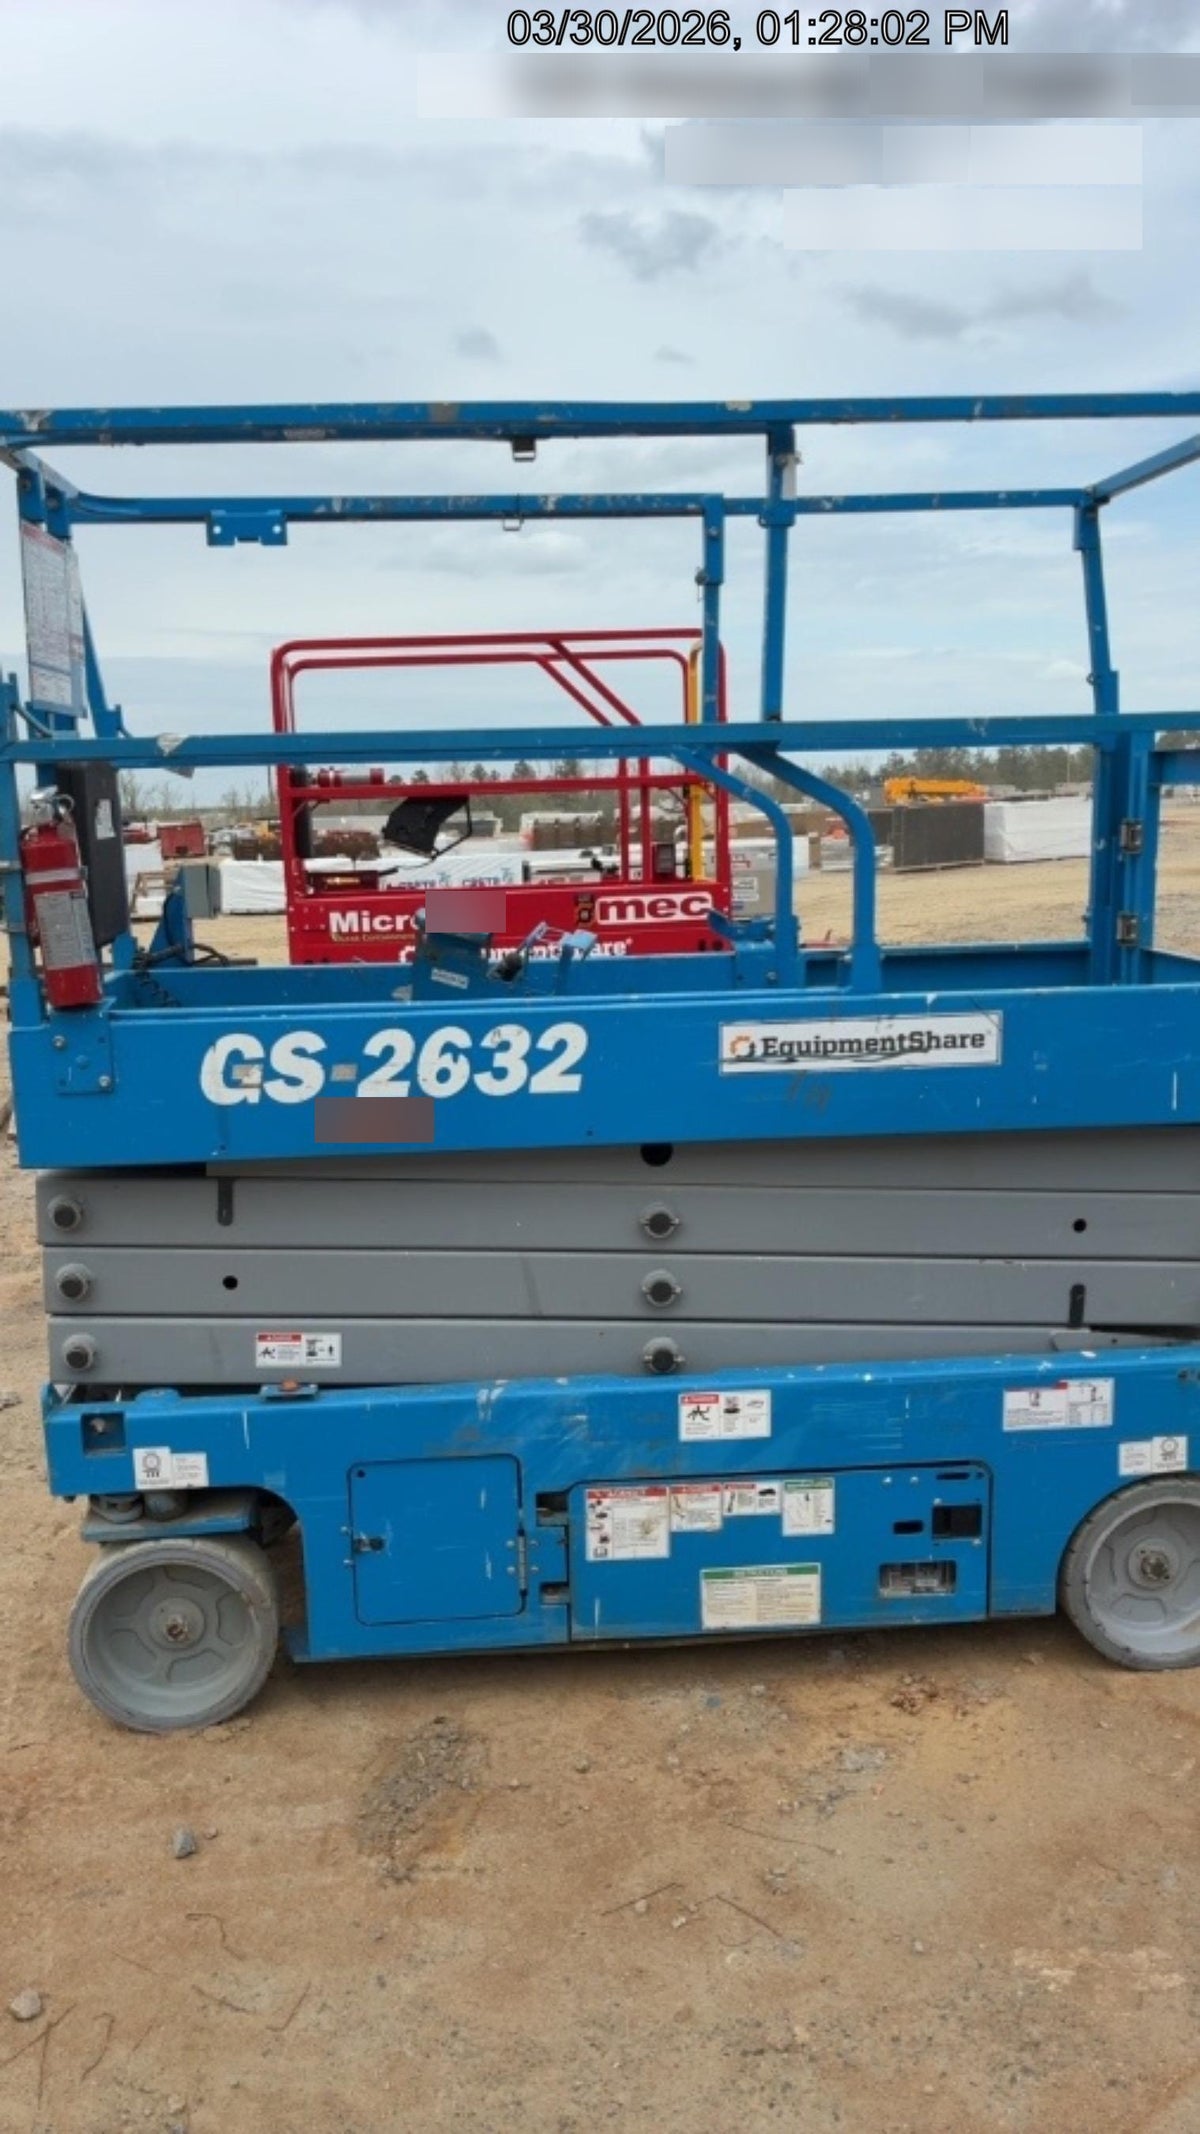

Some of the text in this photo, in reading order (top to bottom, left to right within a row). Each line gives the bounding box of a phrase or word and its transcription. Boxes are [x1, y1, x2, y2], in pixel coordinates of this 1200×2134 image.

[600, 896, 709, 921] mec
[760, 1030, 986, 1058] EquipmentShare
[200, 1022, 589, 1105] GS-2632
